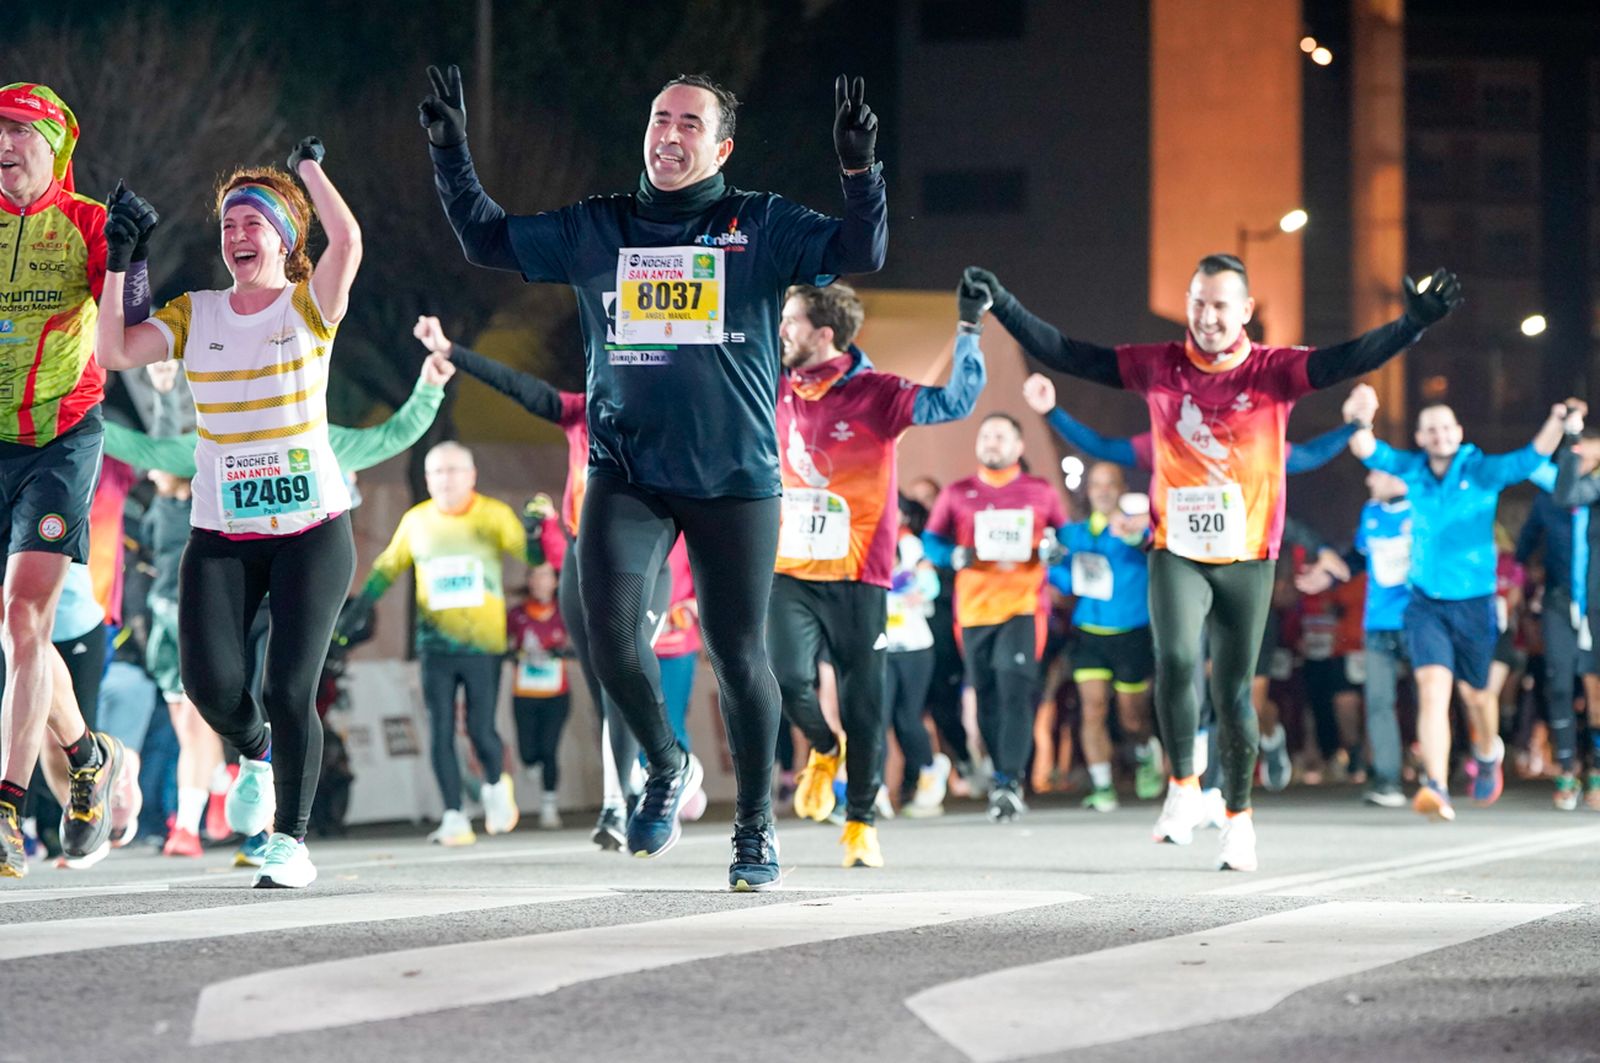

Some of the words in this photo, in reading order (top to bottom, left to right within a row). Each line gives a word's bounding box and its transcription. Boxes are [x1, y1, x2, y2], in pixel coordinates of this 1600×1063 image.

[640, 258, 671, 268] NOCHE
[673, 258, 684, 267] DE
[628, 270, 648, 280] SAN
[0, 290, 63, 303] YUNDAI
[637, 282, 703, 310] 8037
[236, 457, 265, 468] NOCHE
[267, 455, 279, 464] DE
[227, 469, 246, 481] SAN
[229, 475, 310, 509] 12469
[1188, 512, 1225, 533] 520
